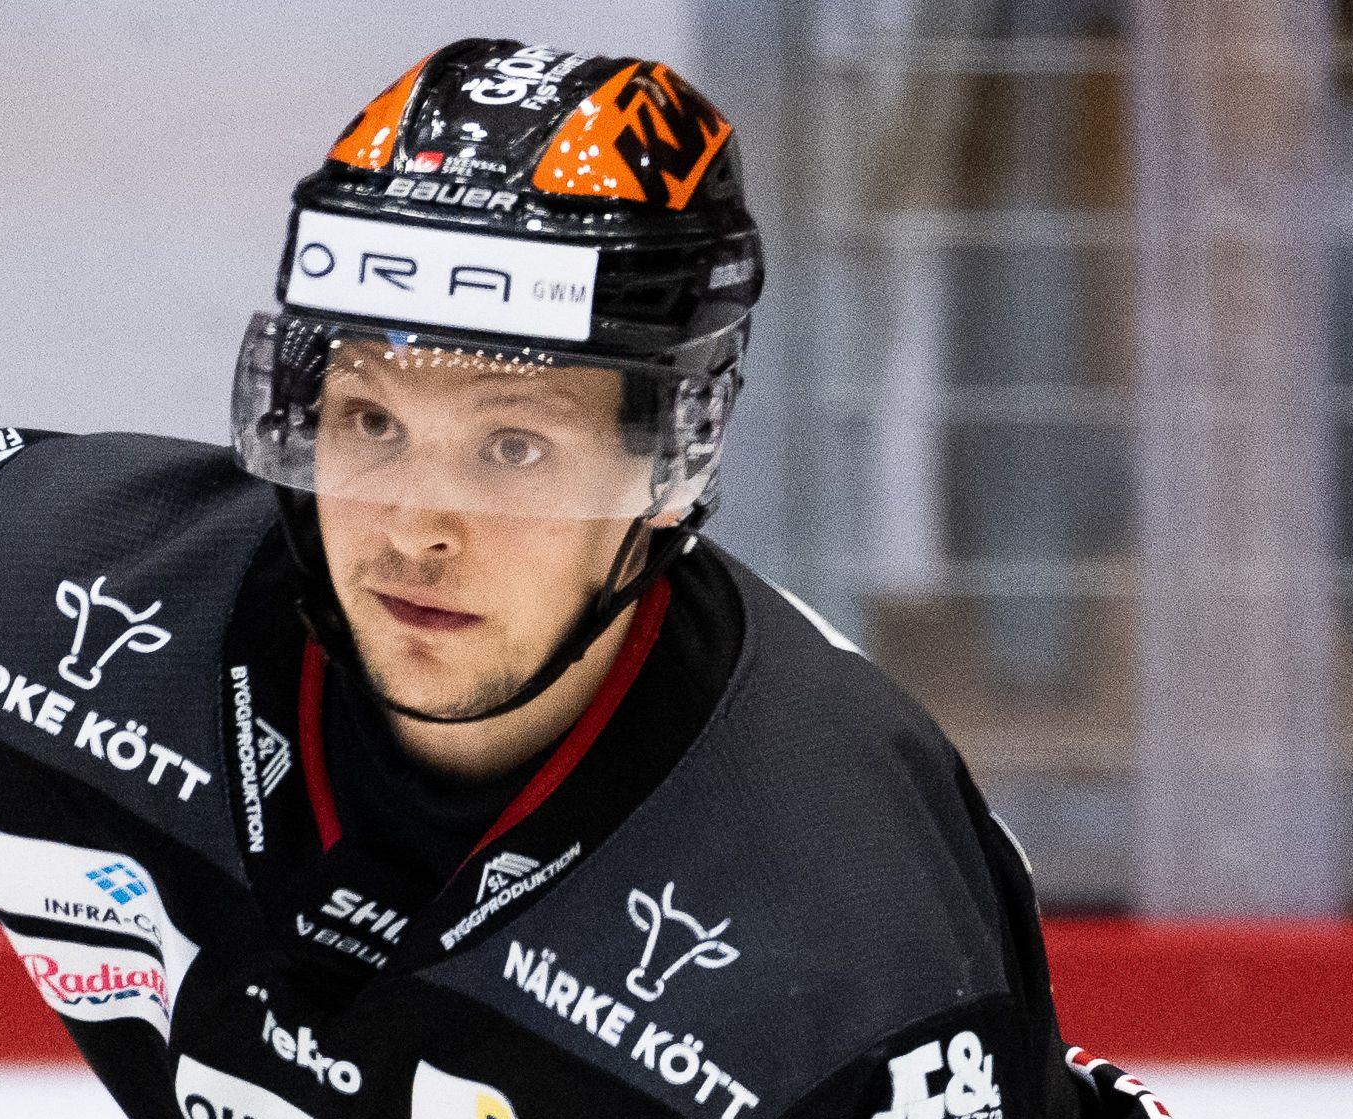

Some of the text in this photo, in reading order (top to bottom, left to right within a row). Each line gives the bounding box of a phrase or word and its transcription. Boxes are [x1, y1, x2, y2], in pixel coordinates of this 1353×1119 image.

[299, 242, 587, 305] ORA GWM
[73, 710, 212, 802] KÖTT
[440, 841, 582, 951] BYGGPRODUKTION
[487, 873, 509, 894] SL
[503, 940, 636, 1048] NÄRKE
